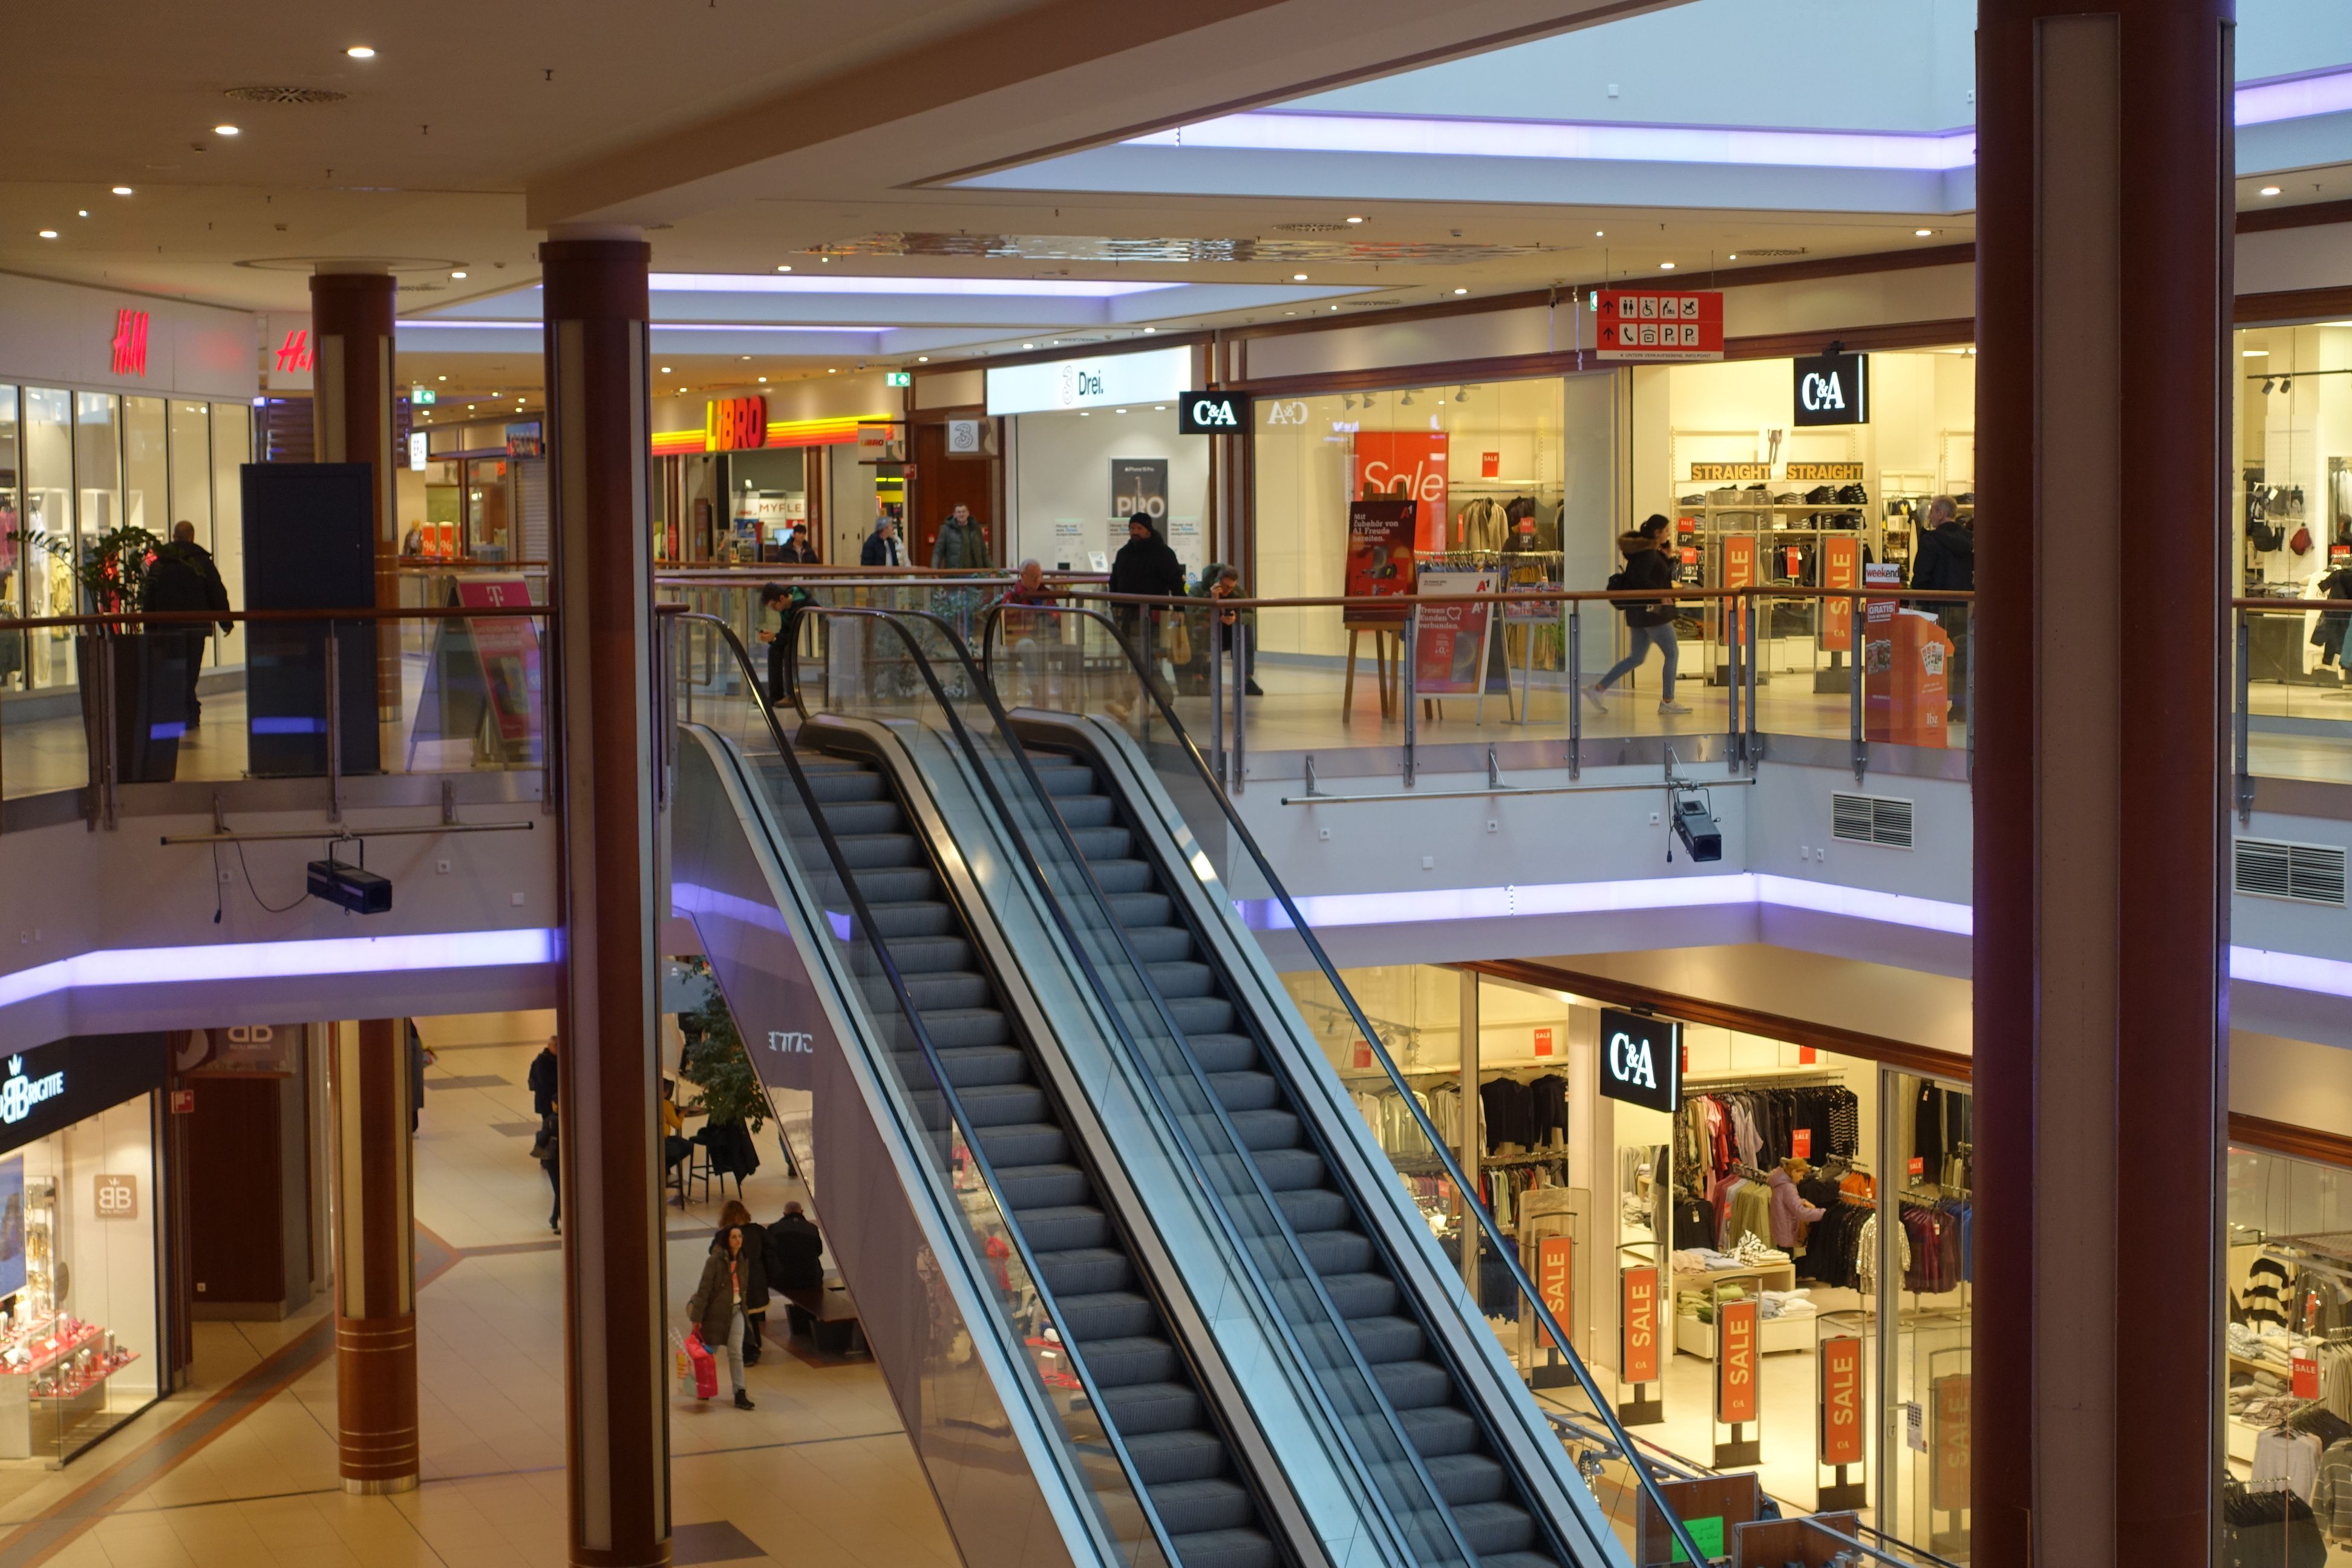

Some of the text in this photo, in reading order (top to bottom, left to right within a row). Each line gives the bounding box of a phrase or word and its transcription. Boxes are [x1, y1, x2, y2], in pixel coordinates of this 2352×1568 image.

[113, 309, 148, 377] H&M
[275, 330, 313, 373] H&
[1079, 370, 1103, 396] Drei.
[1802, 371, 1845, 411] C&A
[705, 394, 766, 452] LIBRO
[1193, 400, 1237, 425] C&A
[1361, 460, 1444, 502] Sale
[1692, 464, 1771, 480] STRAIGHT
[1786, 464, 1863, 480] STRAIGHT
[1117, 496, 1165, 518] PRO
[1400, 505, 1413, 520] A1
[1476, 579, 1490, 592] A1
[1867, 567, 1900, 578] weekend
[1471, 601, 1484, 614] A1
[1869, 604, 1894, 615] GRATIS
[1610, 1033, 1657, 1089] C&A
[1547, 1253, 1565, 1313] SALE
[1632, 1284, 1651, 1347] SALE
[1730, 1319, 1749, 1385] SALE
[2295, 1364, 2316, 1374] SALE
[1834, 1356, 1854, 1426] SALE
